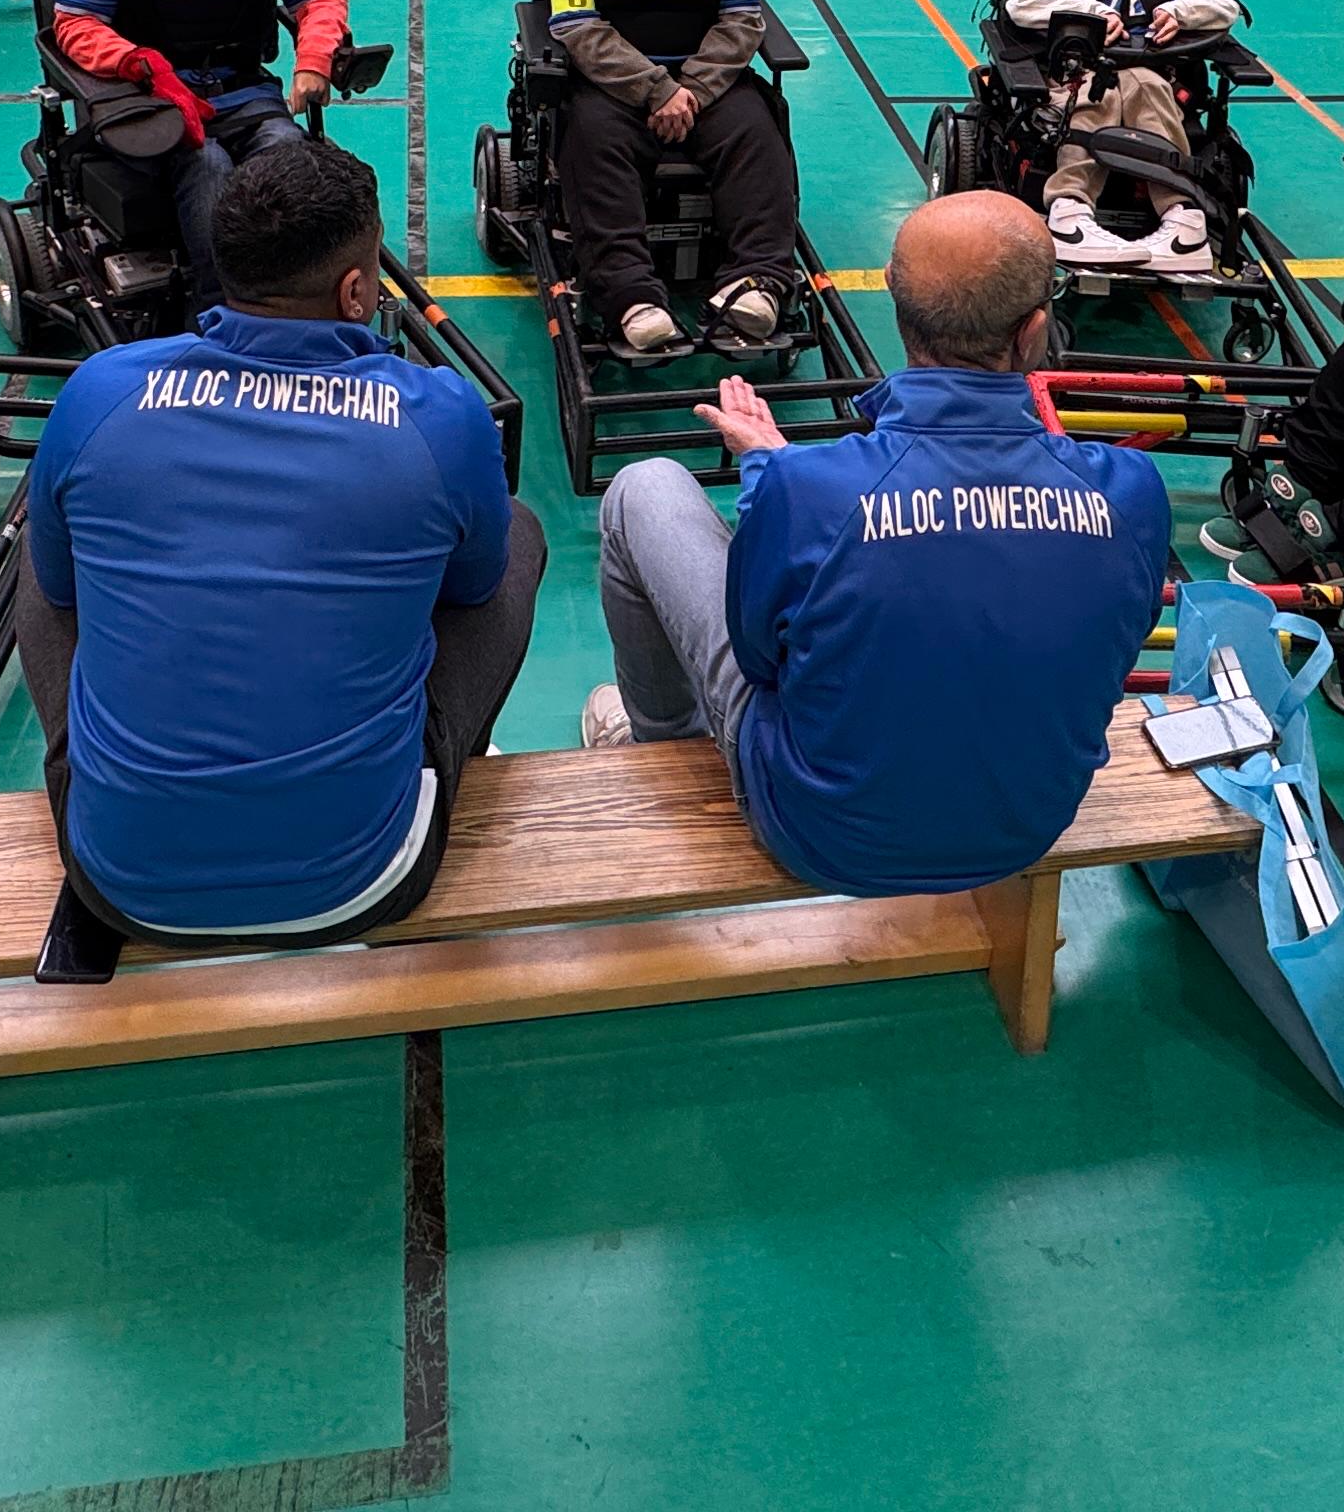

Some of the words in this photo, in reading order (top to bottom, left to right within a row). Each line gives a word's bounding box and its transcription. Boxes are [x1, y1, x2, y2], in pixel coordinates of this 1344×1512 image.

[138, 369, 230, 411] XALOC
[234, 370, 401, 429] POWERCHAIR
[859, 488, 946, 543] XALOC
[953, 485, 1113, 539] POWERCHAIR
